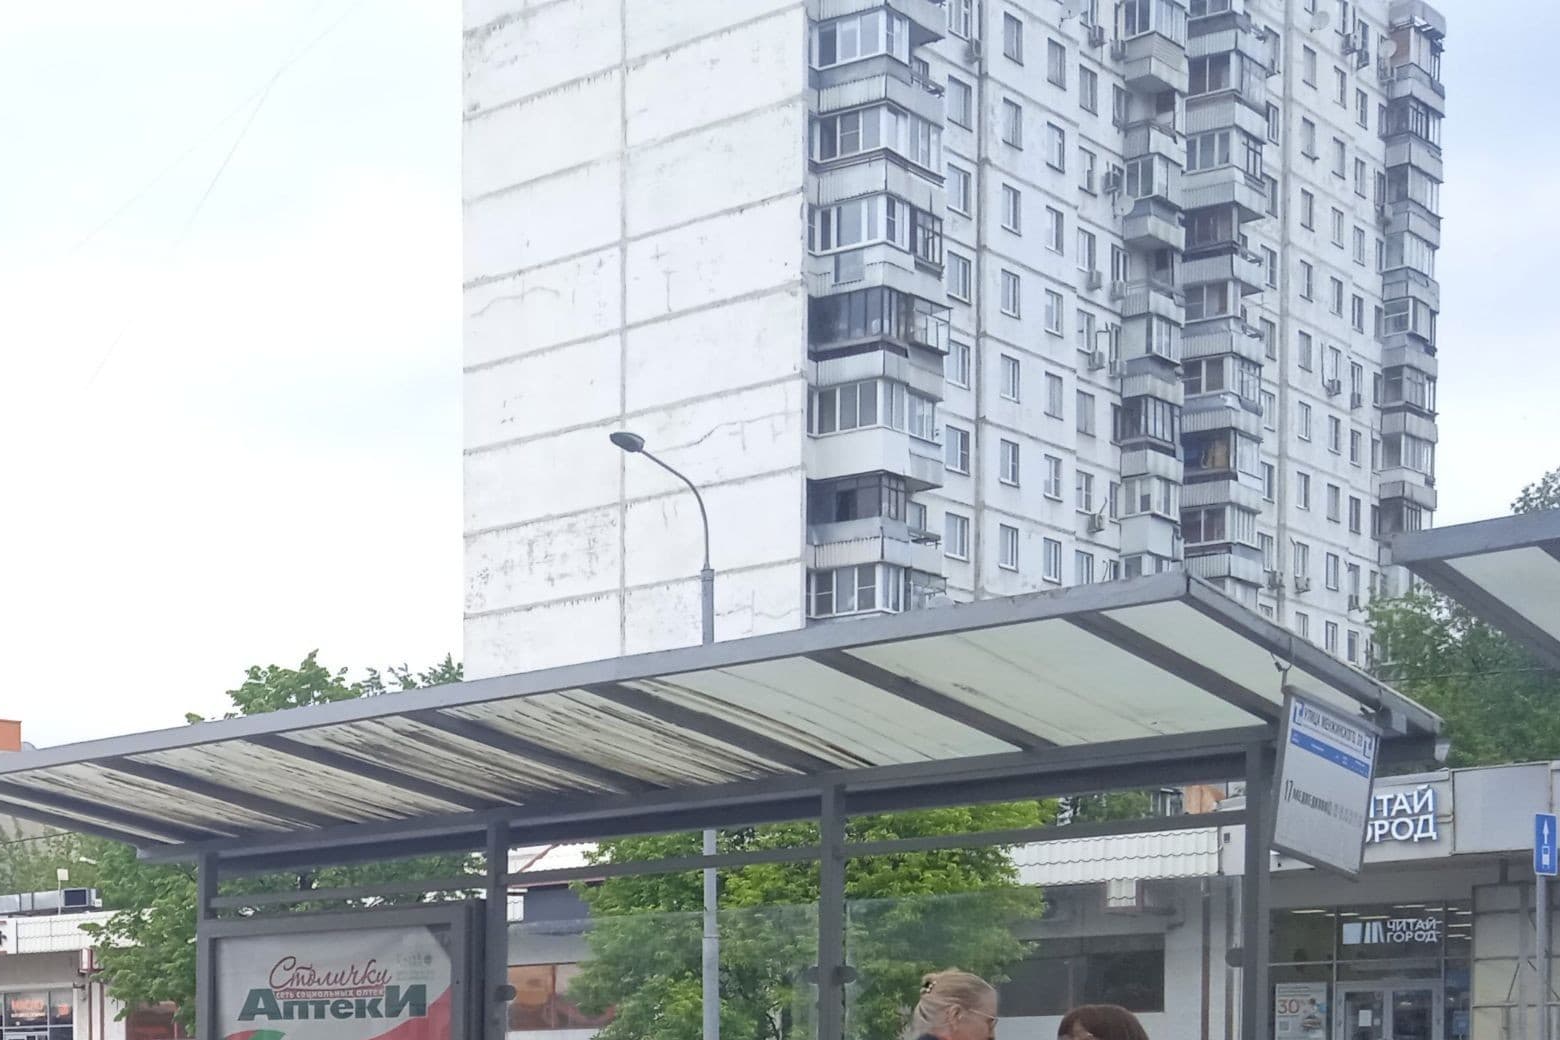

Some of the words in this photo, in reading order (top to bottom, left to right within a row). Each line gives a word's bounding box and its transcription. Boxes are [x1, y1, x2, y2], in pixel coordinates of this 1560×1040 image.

[1285, 780, 1293, 801] 17
[1370, 784, 1435, 818] ТАЙ
[1366, 814, 1438, 843] РОД
[1387, 916, 1437, 931] ЧИТАЙ
[1387, 930, 1438, 943] ГОРОД
[269, 955, 392, 990] Столички
[276, 991, 295, 1000] сеть
